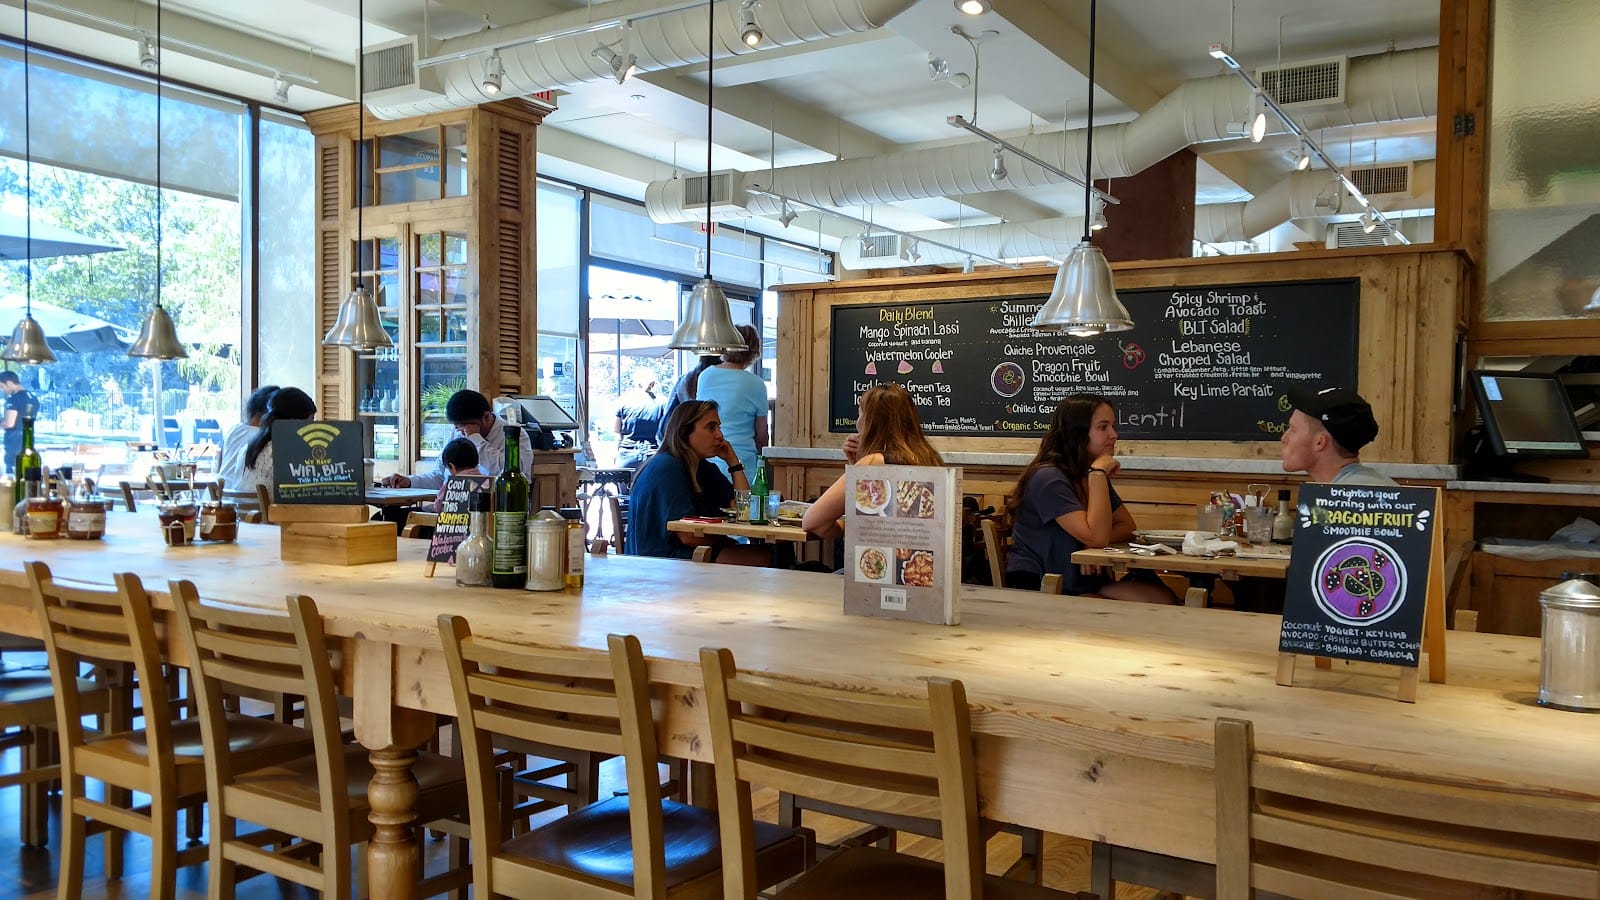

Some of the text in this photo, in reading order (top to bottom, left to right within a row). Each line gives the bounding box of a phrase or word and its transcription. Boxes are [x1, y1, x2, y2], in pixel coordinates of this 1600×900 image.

[1170, 292, 1203, 308] Spicy
[1206, 291, 1251, 306] Shrimp
[1000, 301, 1044, 314] Summe
[1165, 300, 1267, 318] Avocado Toast
[880, 306, 934, 325] Daily Blend
[860, 320, 960, 343] Mango Spinach Lassi
[1183, 319, 1245, 335] BLT Salad
[1004, 342, 1096, 357] Quiche Provençale
[1172, 340, 1241, 353] Lebanese
[865, 348, 954, 361] Watermelon Cooler
[1159, 352, 1251, 368] Chopped Salad
[1032, 358, 1101, 373] Dragon Fruit
[1032, 370, 1110, 382] Smoothie Bowl
[853, 380, 872, 392] Iced
[907, 380, 935, 393] Green
[935, 382, 951, 393] Tea
[1174, 383, 1274, 400] Key Lime Parfait
[912, 393, 933, 406] ibos
[935, 395, 951, 406] Tea
[1012, 403, 1057, 414] Chilled Gaz
[1118, 401, 1184, 428] Lentil
[1002, 421, 1031, 431] Organic
[1266, 421, 1287, 433] Bot
[289, 462, 354, 478] WIFI, BUT...
[1330, 487, 1400, 501] brighten your
[442, 501, 459, 513] THIS
[1315, 498, 1365, 511] morning
[1367, 500, 1392, 510] with
[437, 512, 470, 526] SUMMER
[436, 523, 468, 534] WITH OUR
[1322, 526, 1403, 537] SMOOTHIE BOWL
[1281, 631, 1319, 640] AVOCADO
[1323, 634, 1359, 645] CASHEW
[1361, 638, 1396, 649] BUTTER
[1282, 640, 1414, 661] BERRIES BANANA GRANOLA
